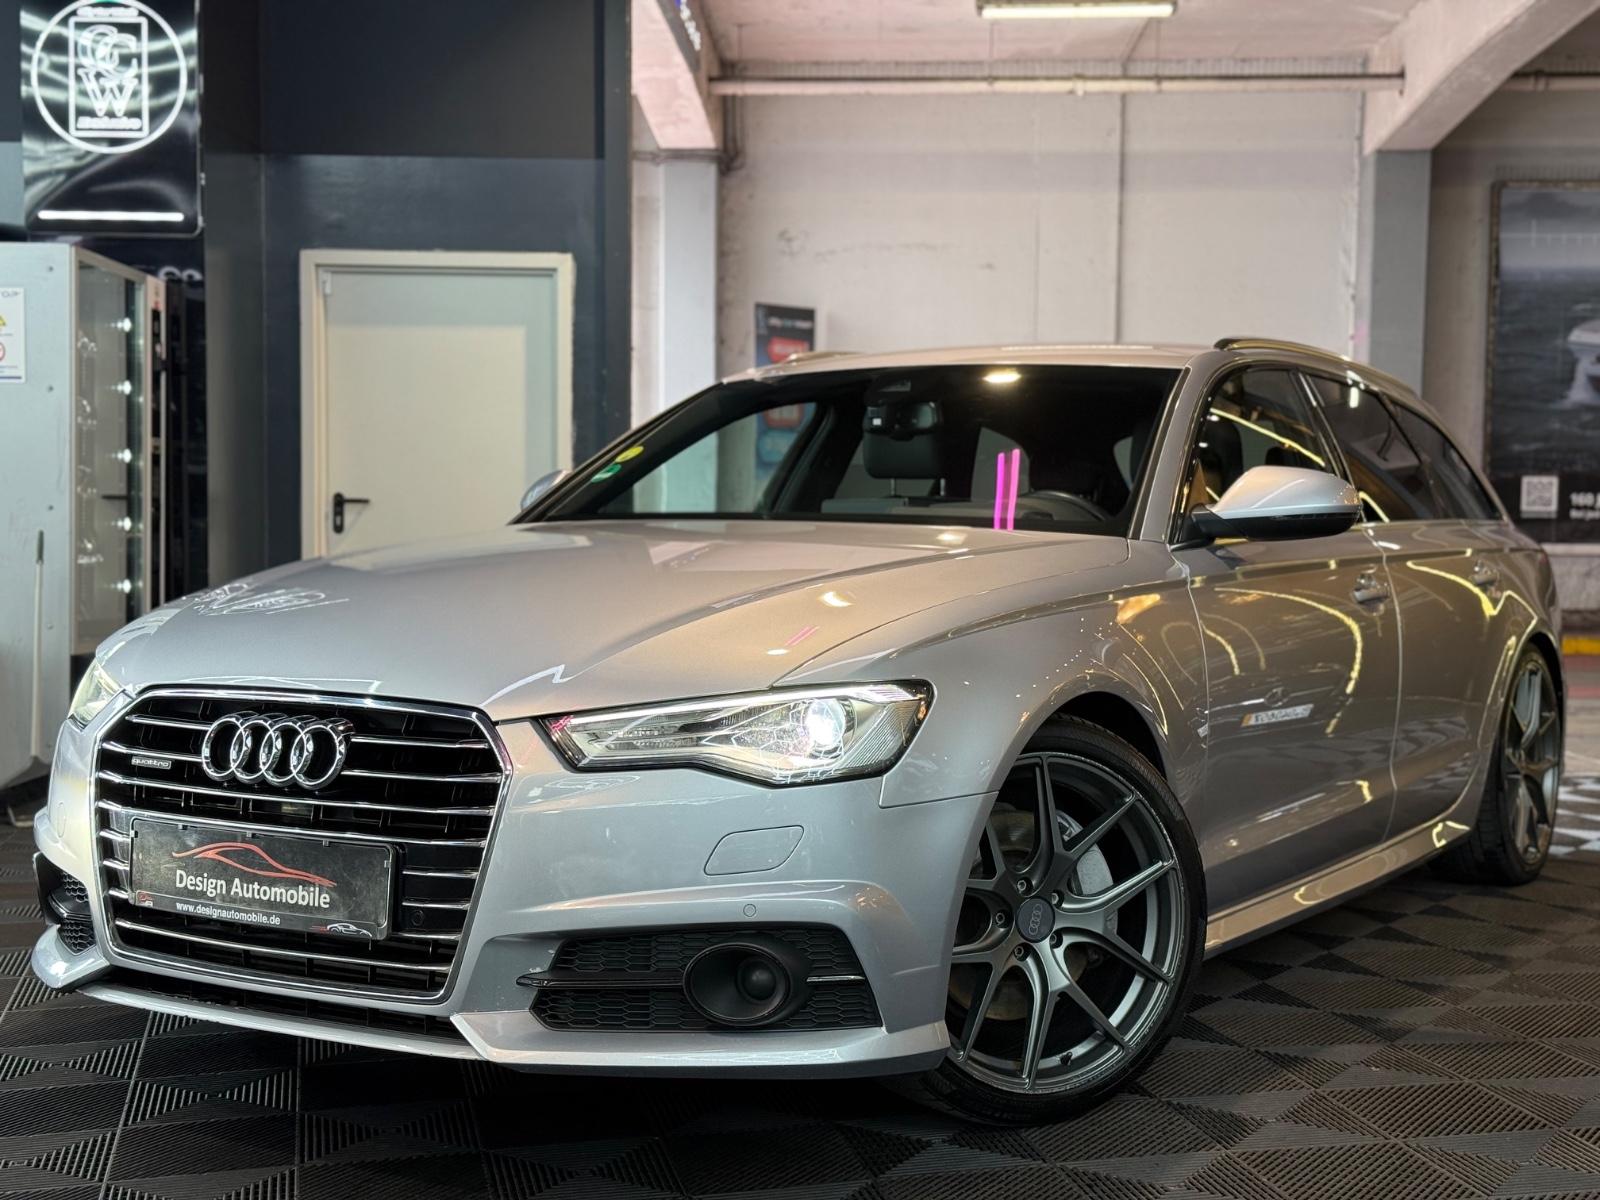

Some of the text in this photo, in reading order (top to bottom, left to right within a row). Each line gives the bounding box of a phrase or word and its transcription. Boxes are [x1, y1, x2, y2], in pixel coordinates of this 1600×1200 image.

[132, 757, 169, 768] quattro
[175, 869, 331, 909] Design Automobile
[175, 902, 281, 925] www.designautomobile.de
